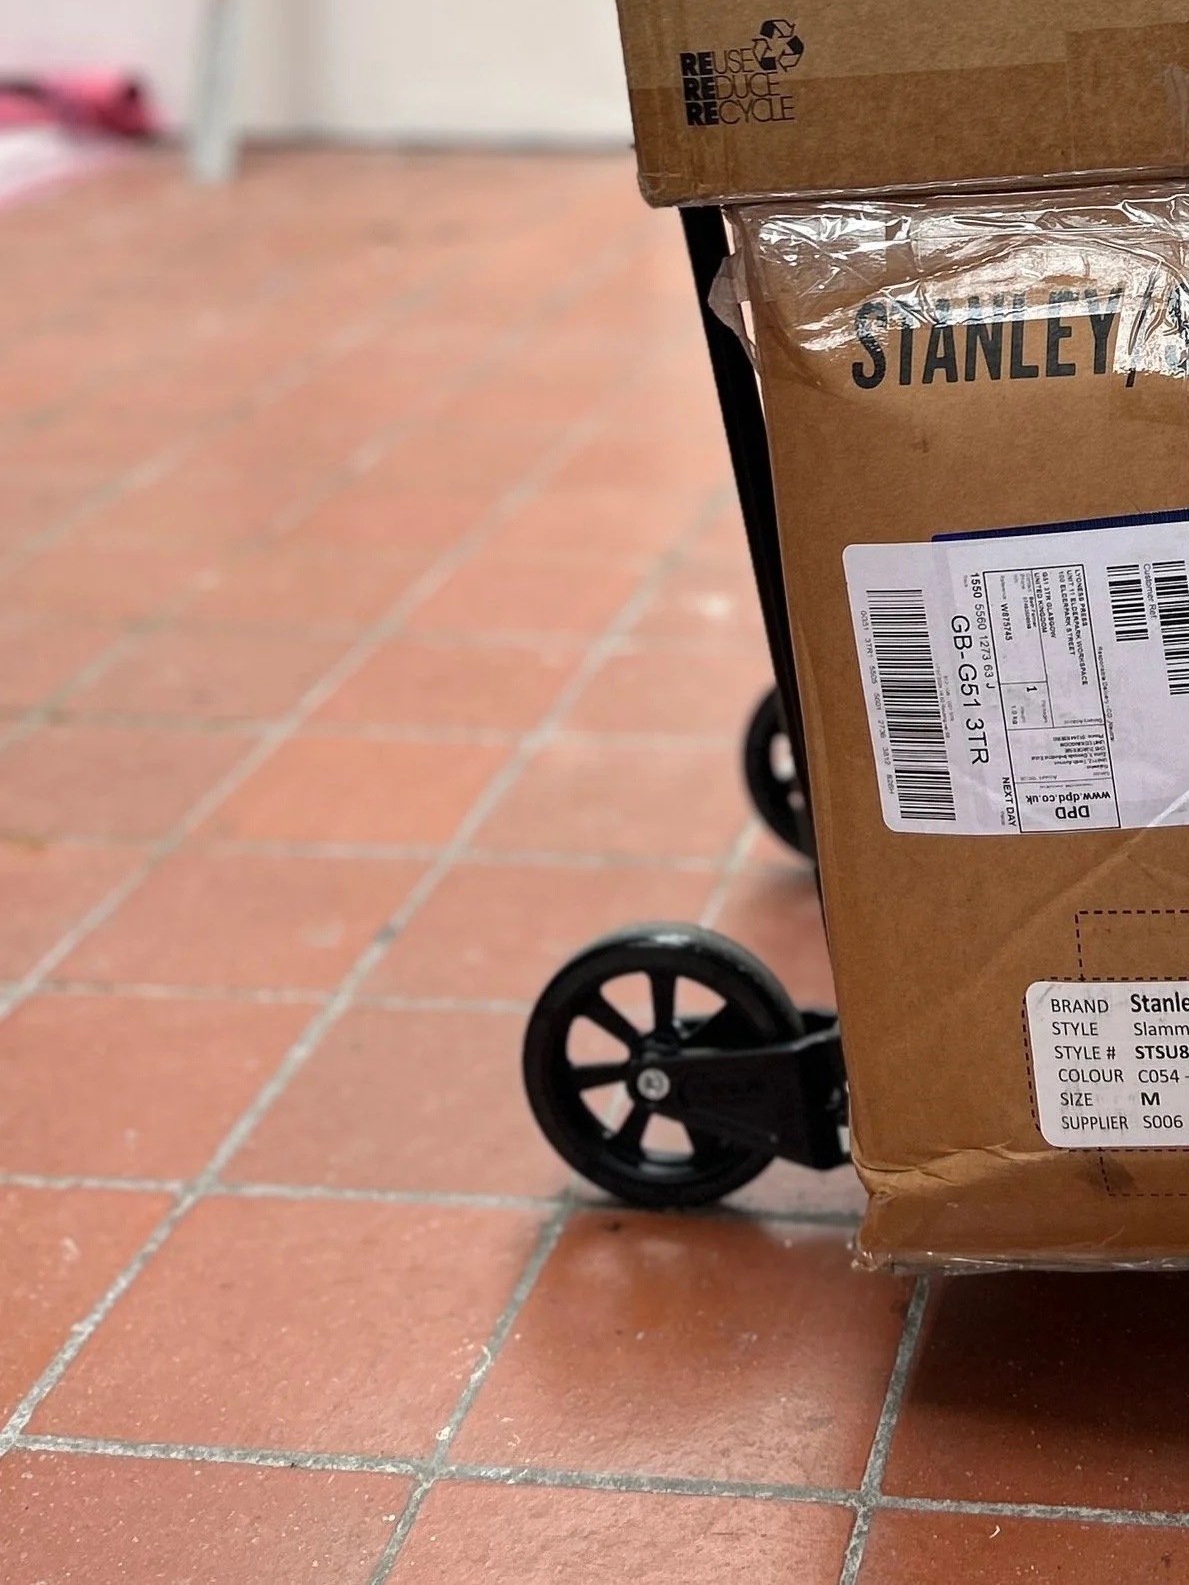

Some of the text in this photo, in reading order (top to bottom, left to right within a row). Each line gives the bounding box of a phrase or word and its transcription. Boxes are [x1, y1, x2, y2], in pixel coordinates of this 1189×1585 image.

[679, 48, 755, 77] REUSE
[682, 71, 781, 101] REDUCE
[685, 96, 796, 126] RECYCLE
[1143, 562, 1157, 602] Customer
[970, 572, 996, 690] 1550 5560 1273 63 J
[1001, 602, 1014, 641] W875745
[966, 716, 991, 765] 3TR
[1001, 775, 1014, 804] NEXT
[1026, 791, 1110, 805] www.dpd.co.uk
[1006, 805, 1017, 827] DAY
[1055, 805, 1090, 819] DPD
[1050, 998, 1109, 1014] BRAND
[1051, 1021, 1099, 1036] STYLE
[1054, 1045, 1101, 1060] STYLE
[1106, 1046, 1116, 1059] #
[1058, 1068, 1124, 1083] COLOUR
[1138, 1068, 1180, 1083] C054
[1060, 1092, 1161, 1107] SIZE M
[1061, 1115, 1129, 1131] SUPPLIER
[1142, 1114, 1184, 1130] S006
